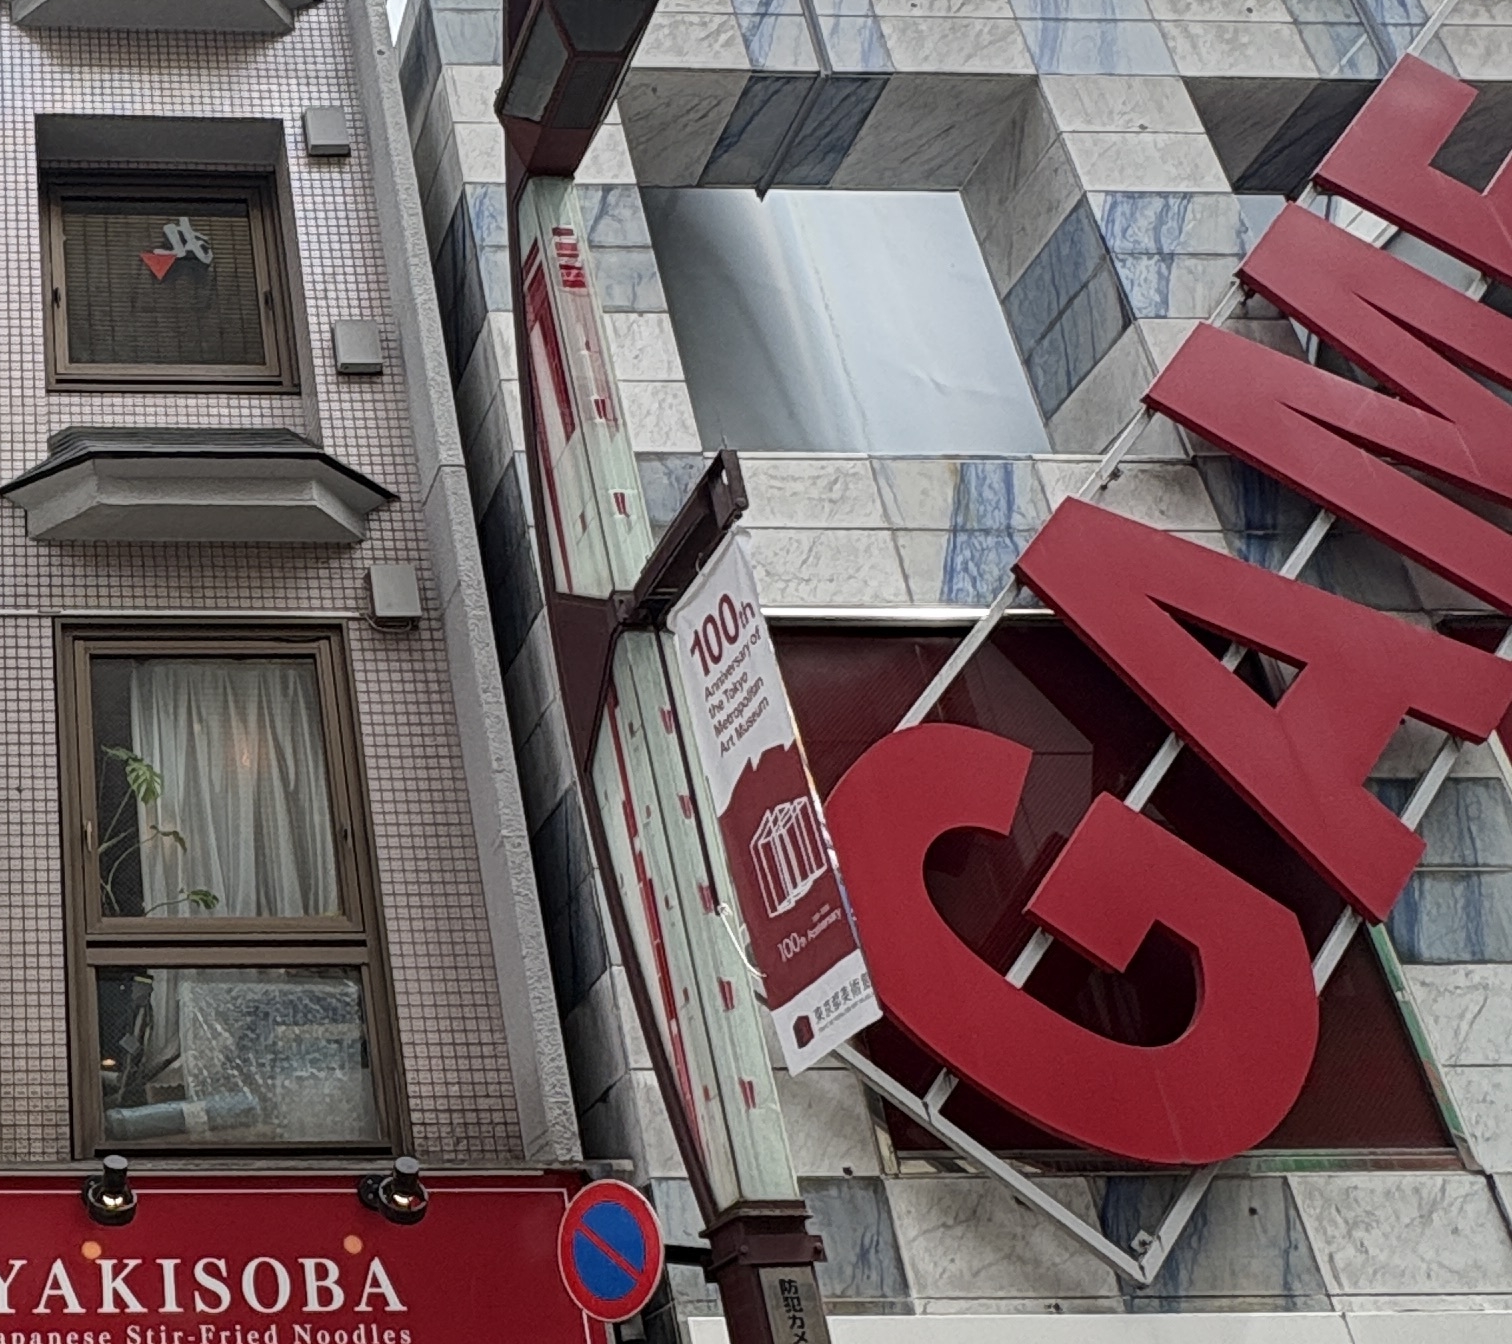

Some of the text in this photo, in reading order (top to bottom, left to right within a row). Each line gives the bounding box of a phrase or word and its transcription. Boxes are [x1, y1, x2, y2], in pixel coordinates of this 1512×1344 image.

[689, 593, 756, 678] 100th
[704, 624, 761, 703] Anniversary of
[708, 671, 749, 720] the Tokyo
[712, 676, 765, 739] Metropolitan
[719, 696, 770, 758] Art Museum
